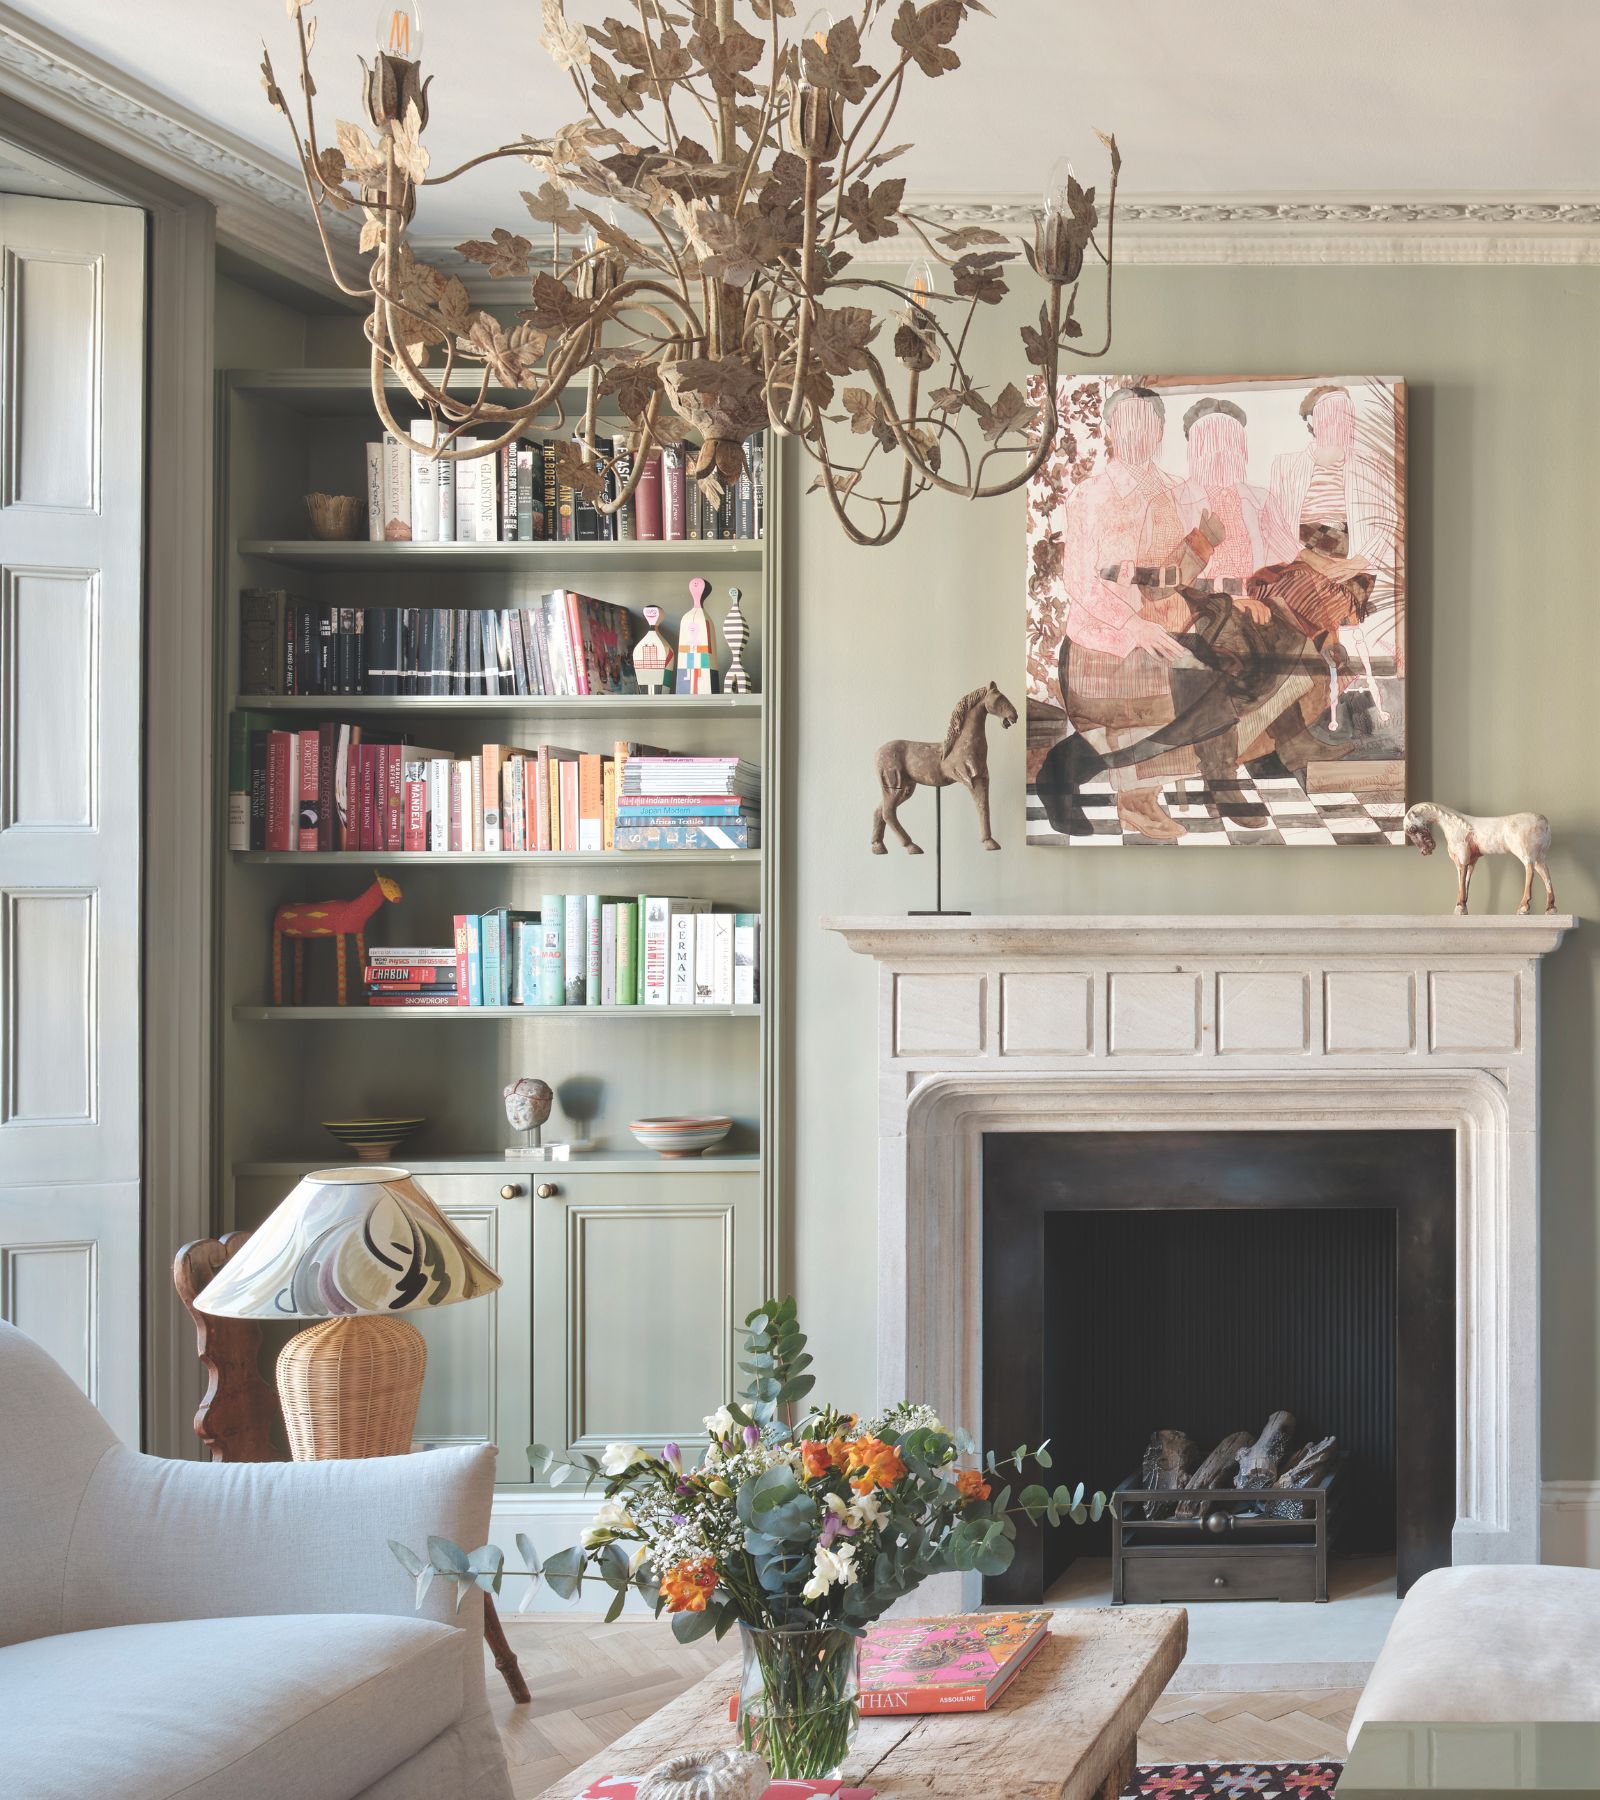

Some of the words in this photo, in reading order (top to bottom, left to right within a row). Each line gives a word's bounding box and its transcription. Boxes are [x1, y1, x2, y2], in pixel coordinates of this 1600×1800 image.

[508, 442, 517, 456] 1000
[544, 446, 555, 461] THE
[391, 448, 400, 485] ANCIENT
[508, 458, 517, 476] YEARS
[544, 463, 555, 486] BOER
[481, 463, 492, 521] GLADSTONE
[508, 478, 516, 489] FOR
[560, 486, 572, 501] AIN
[742, 475, 750, 500] SHOGUN
[391, 488, 400, 515] EGYPT
[508, 490, 517, 516] REVENGE
[544, 487, 556, 507] WAR
[411, 784, 419, 830] MANDELA
[630, 833, 697, 843] SILK
[677, 920, 687, 982] GERMAN
[372, 969, 408, 980] CHABON
[860, 1692, 908, 1708] THAN
